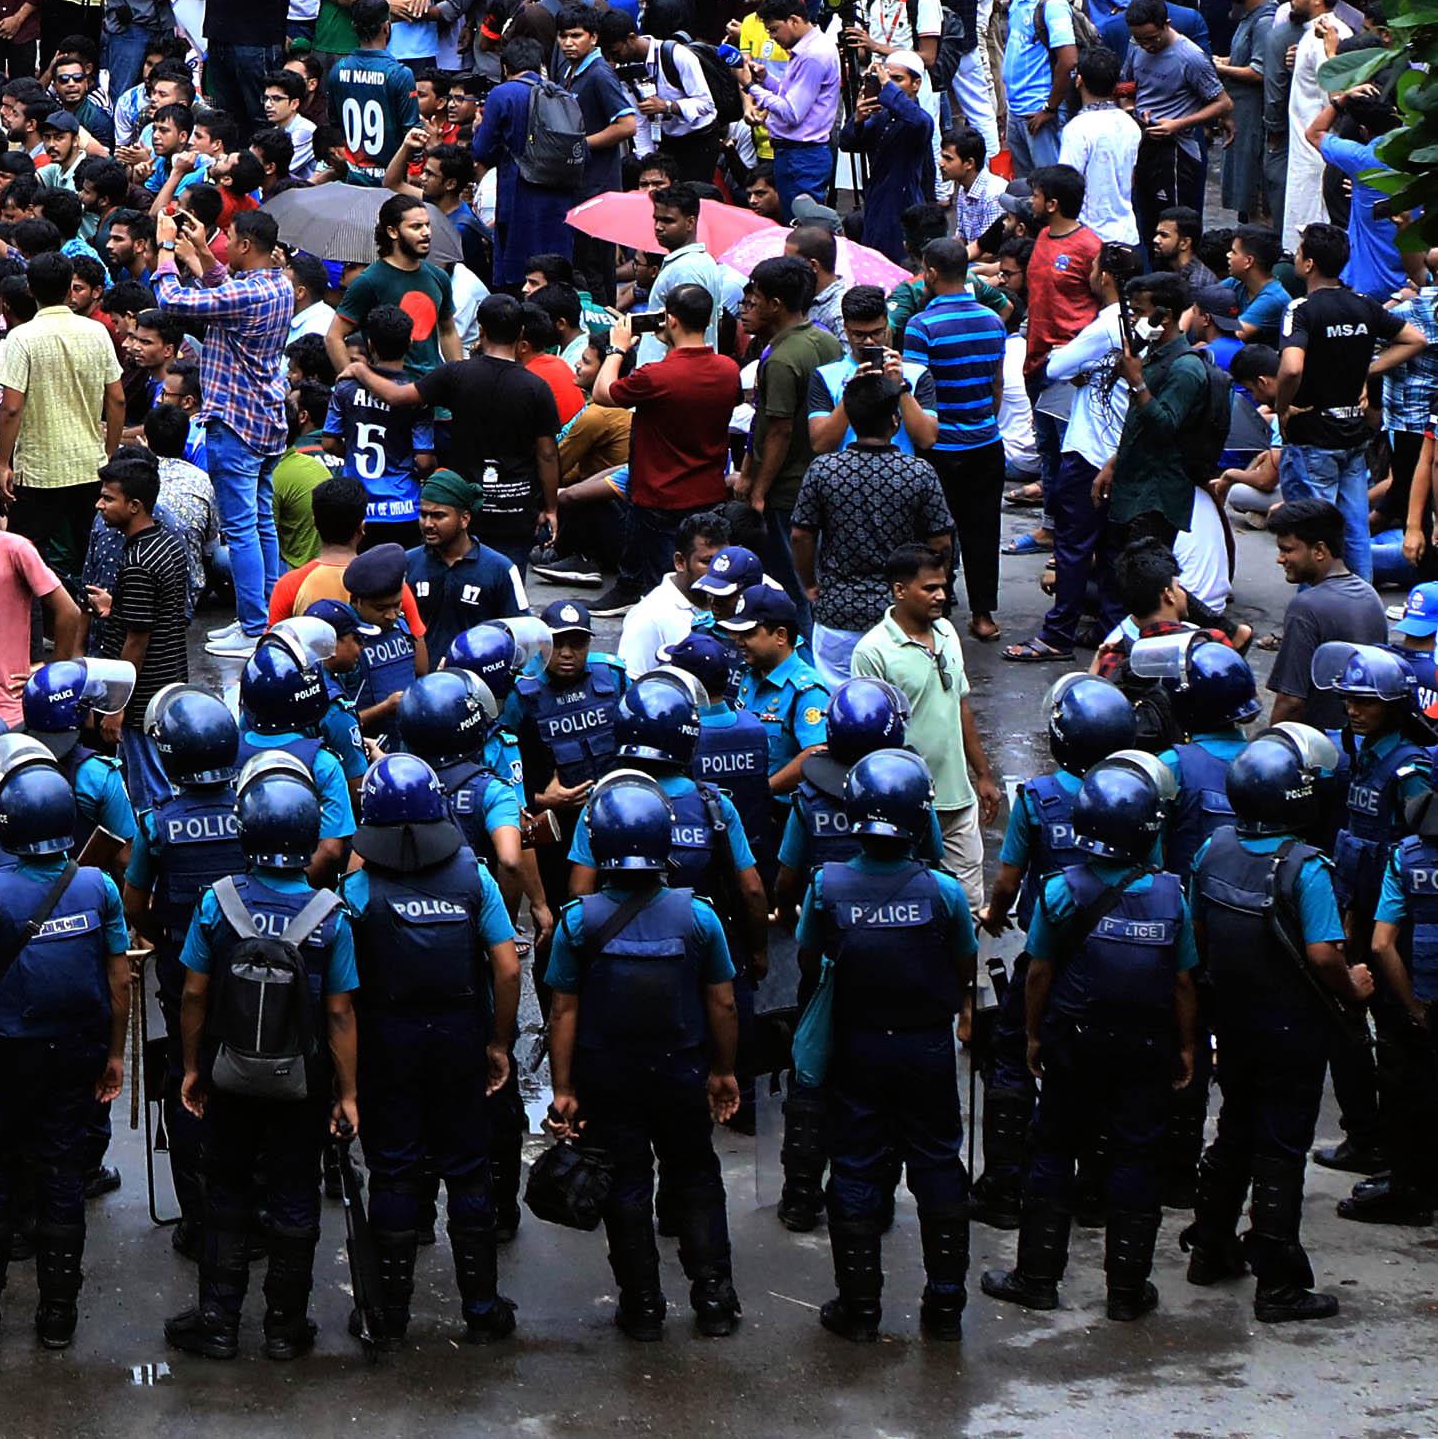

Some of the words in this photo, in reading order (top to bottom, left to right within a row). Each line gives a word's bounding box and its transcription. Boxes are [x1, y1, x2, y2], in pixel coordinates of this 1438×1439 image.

[353, 70, 385, 85] NAHID
[343, 98, 385, 155] 09
[1326, 323, 1369, 337] MSA
[354, 422, 387, 479] 5
[364, 639, 413, 664] POLICE
[483, 659, 506, 673] POLICE
[49, 689, 74, 703] POLICE
[294, 685, 321, 701] POLICE
[460, 712, 482, 731] POLICE
[549, 708, 608, 736] POLICE
[702, 753, 755, 773] POLICE
[169, 815, 239, 840] POLIC
[394, 899, 466, 918] POLICE
[1104, 920, 1159, 939] PLICE
